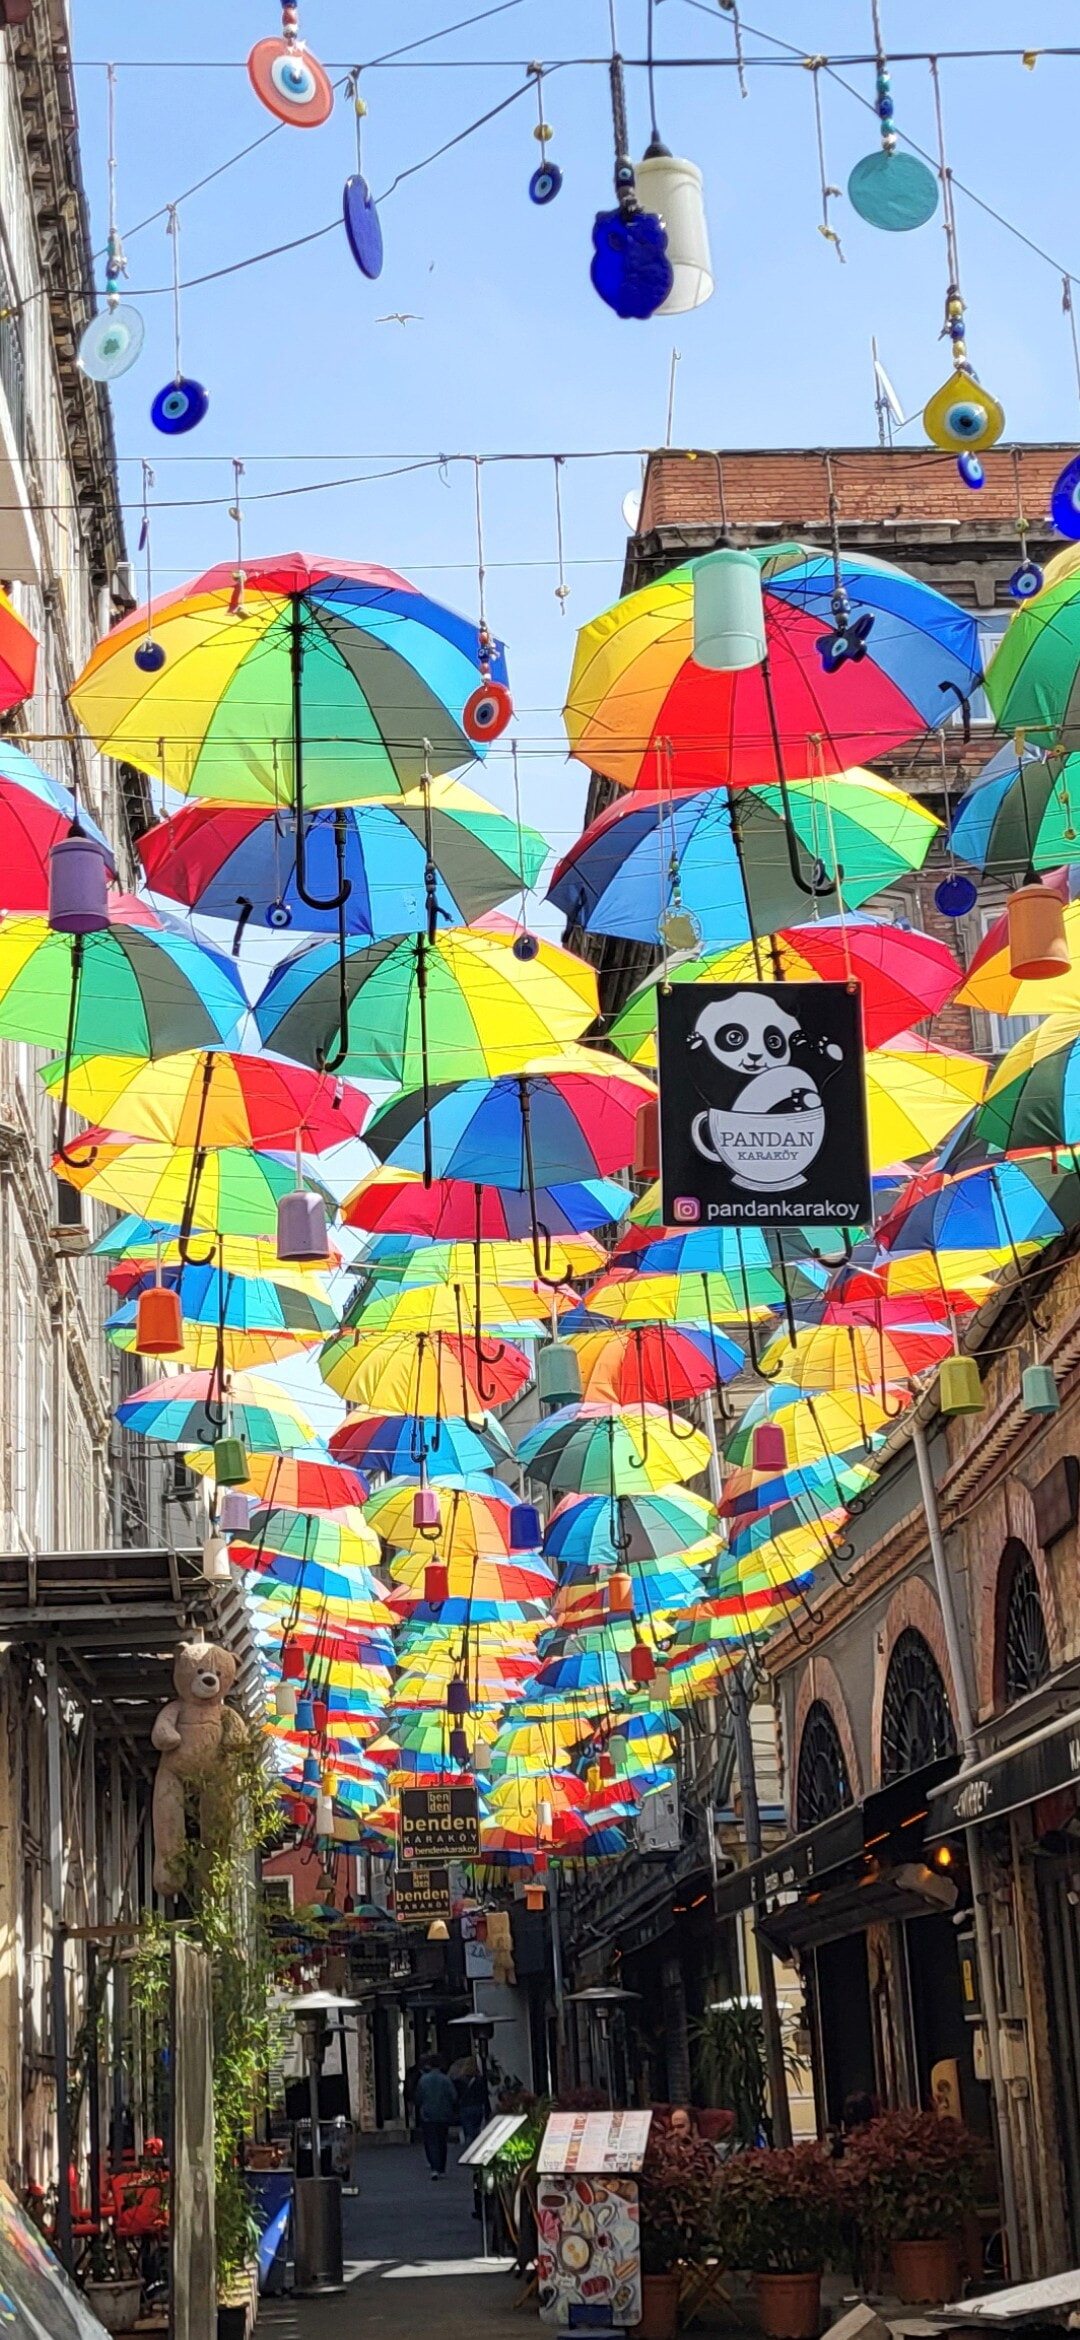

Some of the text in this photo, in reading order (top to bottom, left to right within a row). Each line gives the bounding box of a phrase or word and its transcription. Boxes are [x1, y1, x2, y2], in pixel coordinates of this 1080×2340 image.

[720, 1131, 815, 1147] PANDAN
[737, 1149, 799, 1161] KARAKÖY
[707, 1200, 860, 1220] pandankarakoy
[428, 1793, 449, 1802] ben
[429, 1801, 450, 1811] den
[403, 1814, 477, 1832] benden
[403, 1832, 477, 1844] KARAKÖY
[415, 1845, 478, 1855] bendenkarakoy
[396, 1889, 449, 1902] benden
